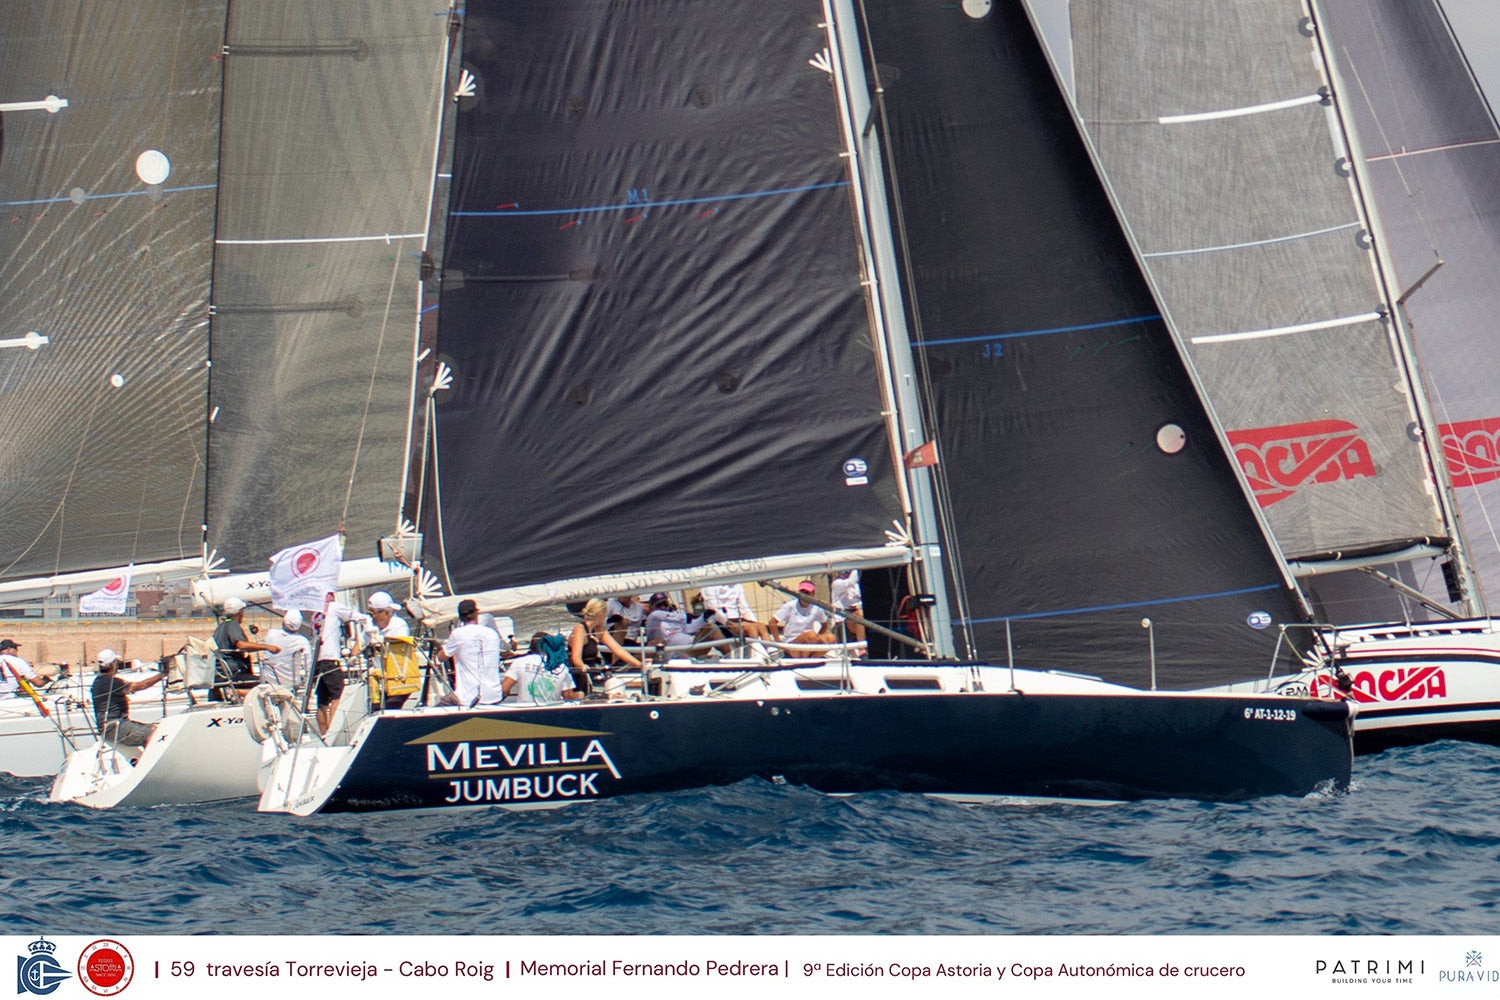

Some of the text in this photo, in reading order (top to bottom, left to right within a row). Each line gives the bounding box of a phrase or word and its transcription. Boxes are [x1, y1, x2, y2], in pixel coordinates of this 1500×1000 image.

[1254, 708, 1297, 721] AT-1-12-19
[426, 739, 623, 779] MEVILLA
[445, 772, 599, 803] JUMBUCK
